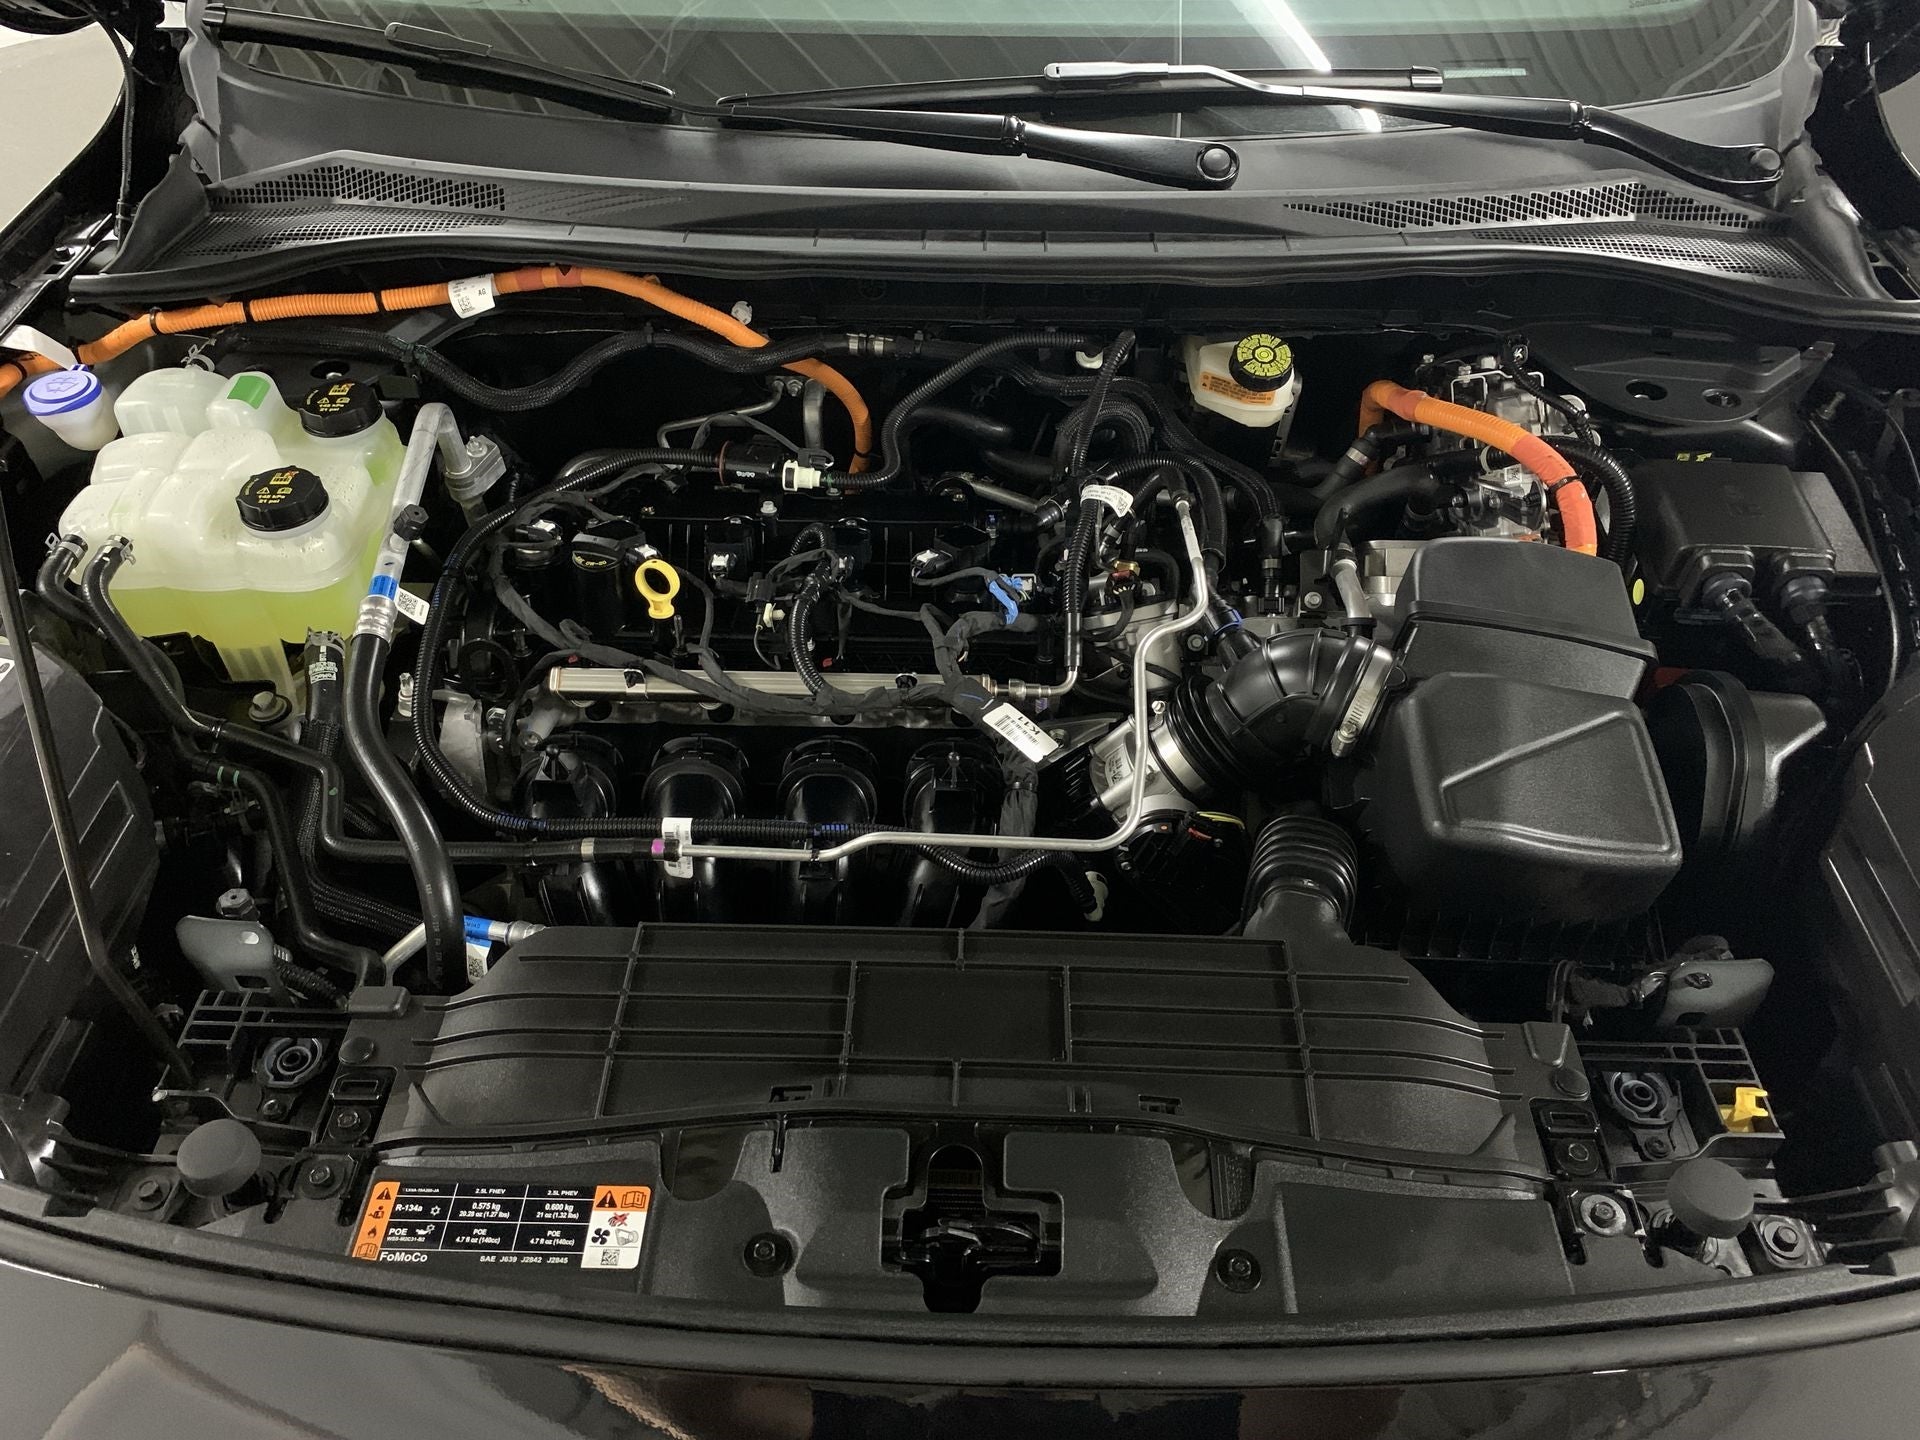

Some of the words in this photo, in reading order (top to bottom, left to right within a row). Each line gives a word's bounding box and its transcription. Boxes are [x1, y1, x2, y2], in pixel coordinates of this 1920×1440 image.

[1017, 716, 1040, 735] K11
[395, 1204, 423, 1212] R-134a
[472, 1202, 490, 1210] 0.575
[491, 1203, 501, 1211] kg
[545, 1203, 564, 1211] 0.600
[565, 1204, 574, 1212] kg
[389, 1228, 408, 1236] POE
[379, 1251, 428, 1263] FoMoCo
